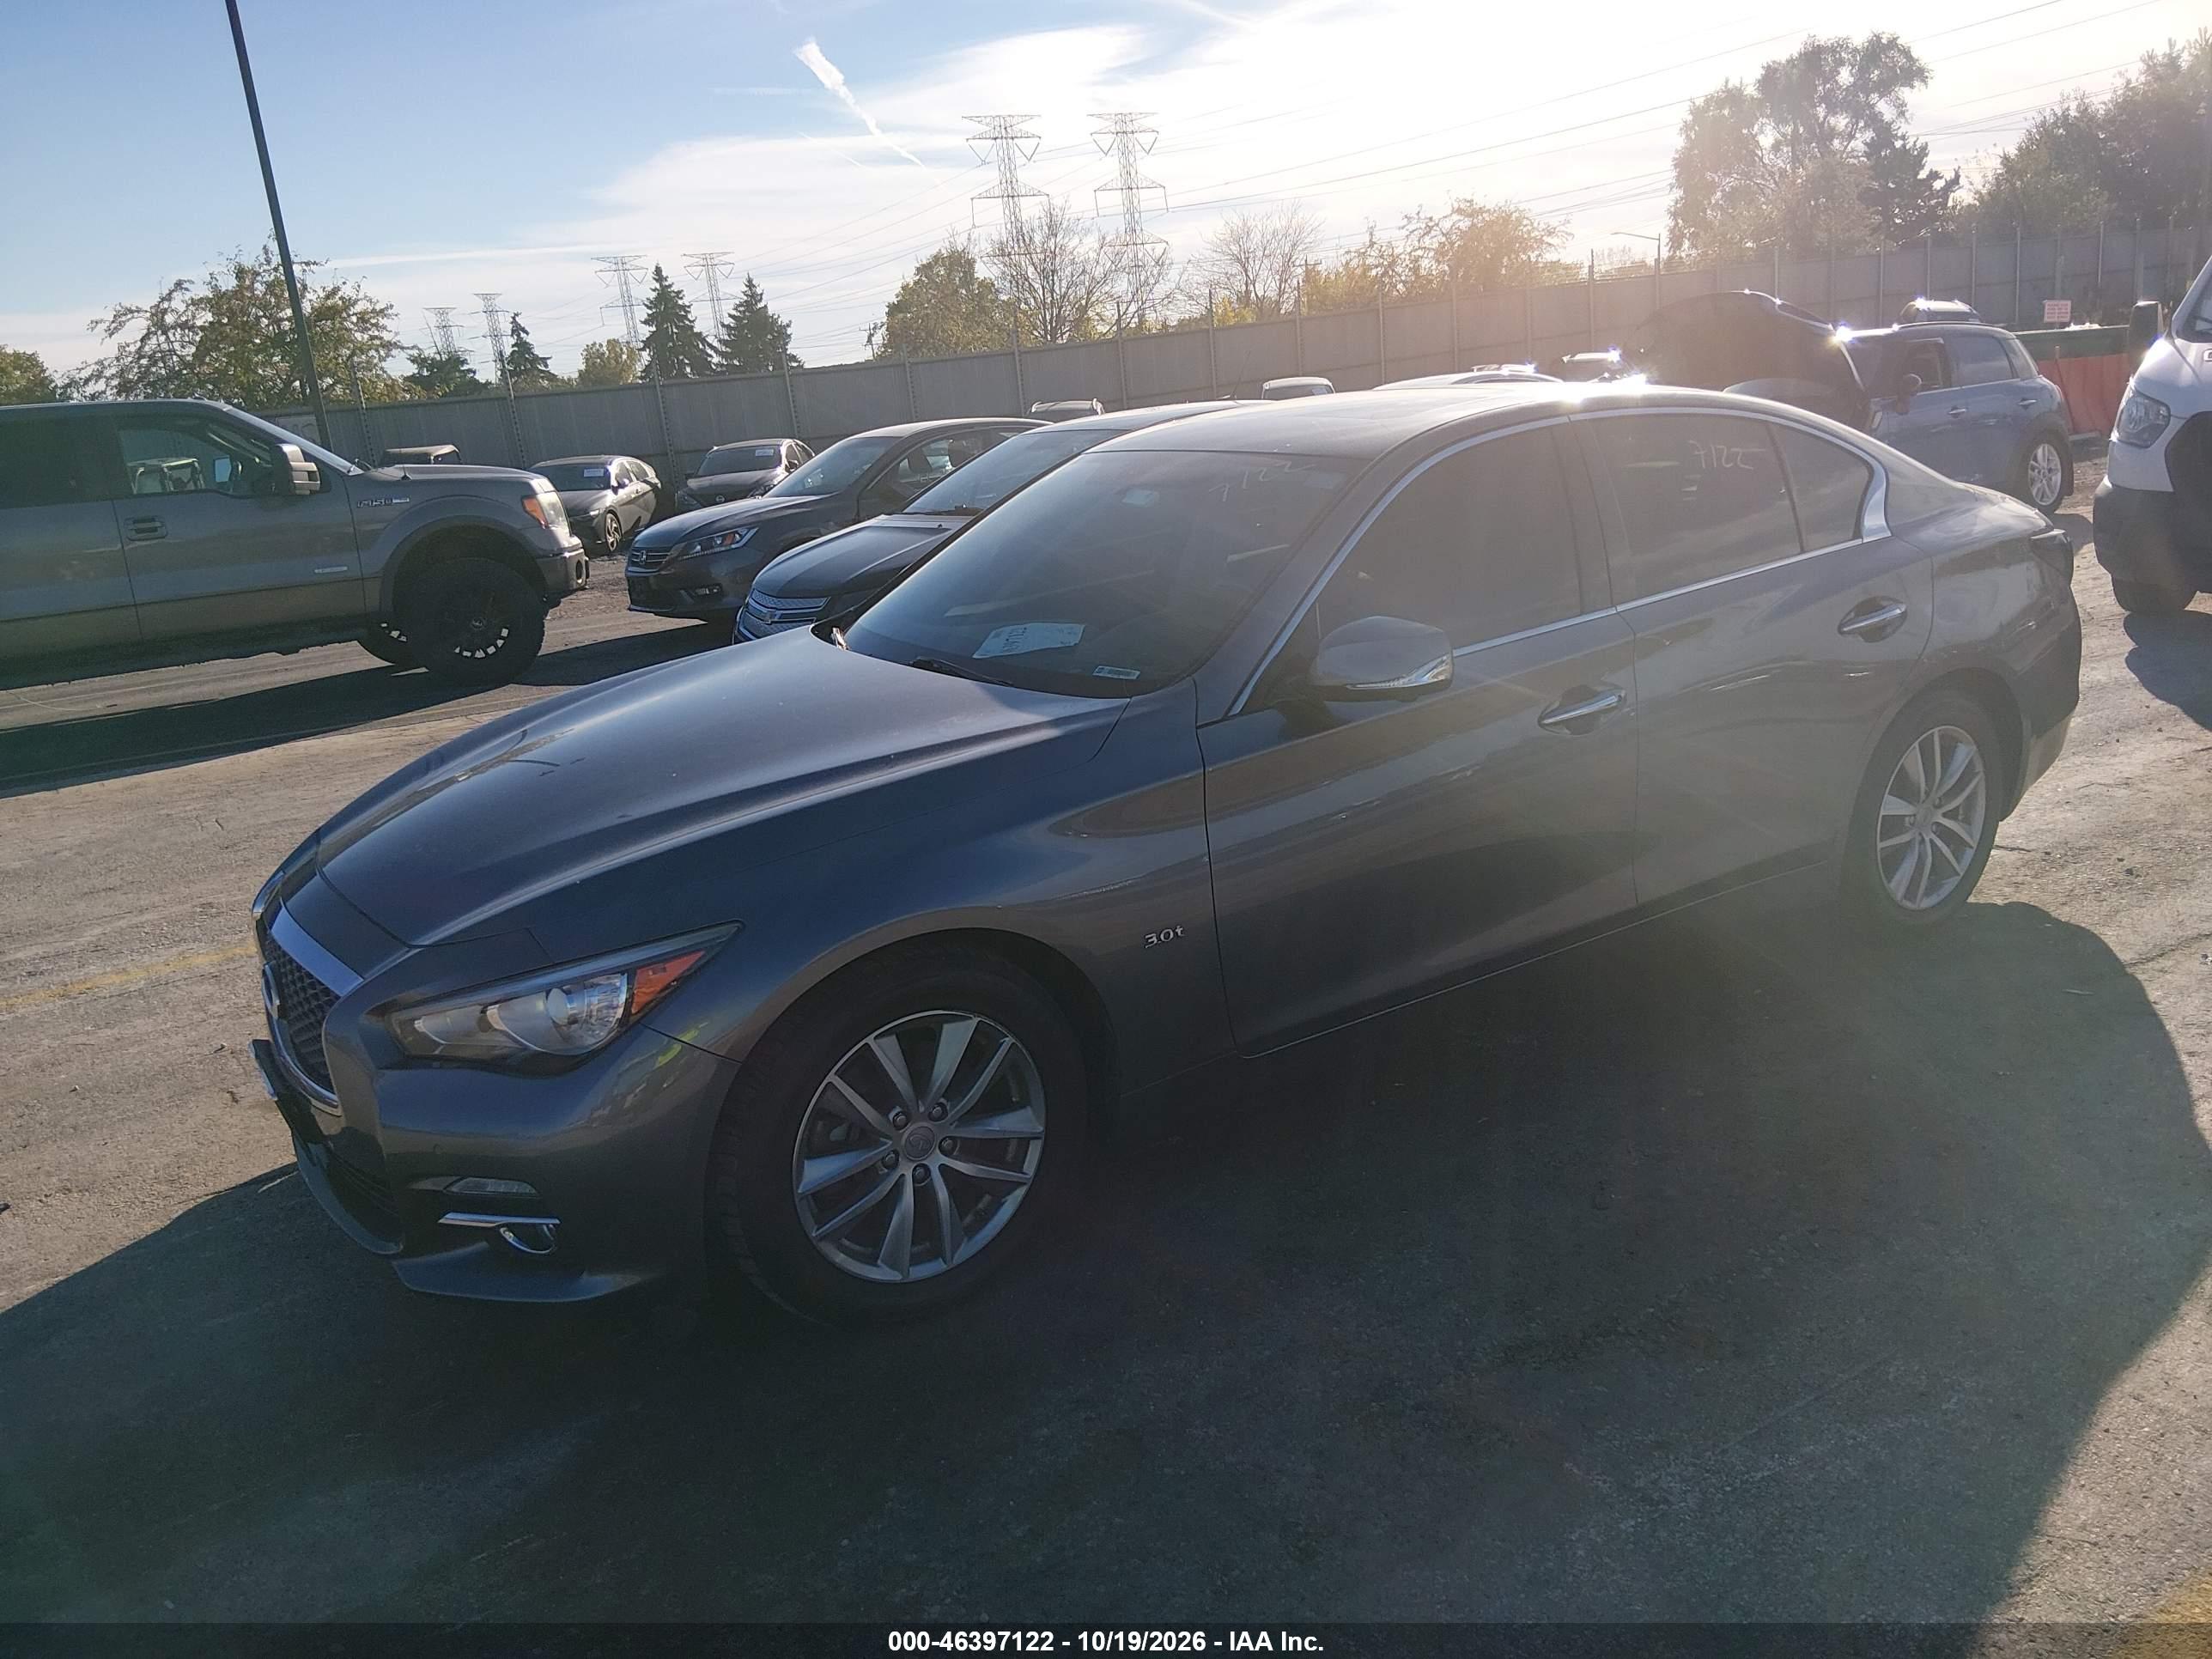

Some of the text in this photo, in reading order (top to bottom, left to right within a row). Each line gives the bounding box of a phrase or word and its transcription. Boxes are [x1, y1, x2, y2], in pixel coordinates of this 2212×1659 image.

[1689, 440, 1766, 470] 7122
[1208, 460, 1316, 502] 7122
[1145, 925, 1185, 949] 3.0t
